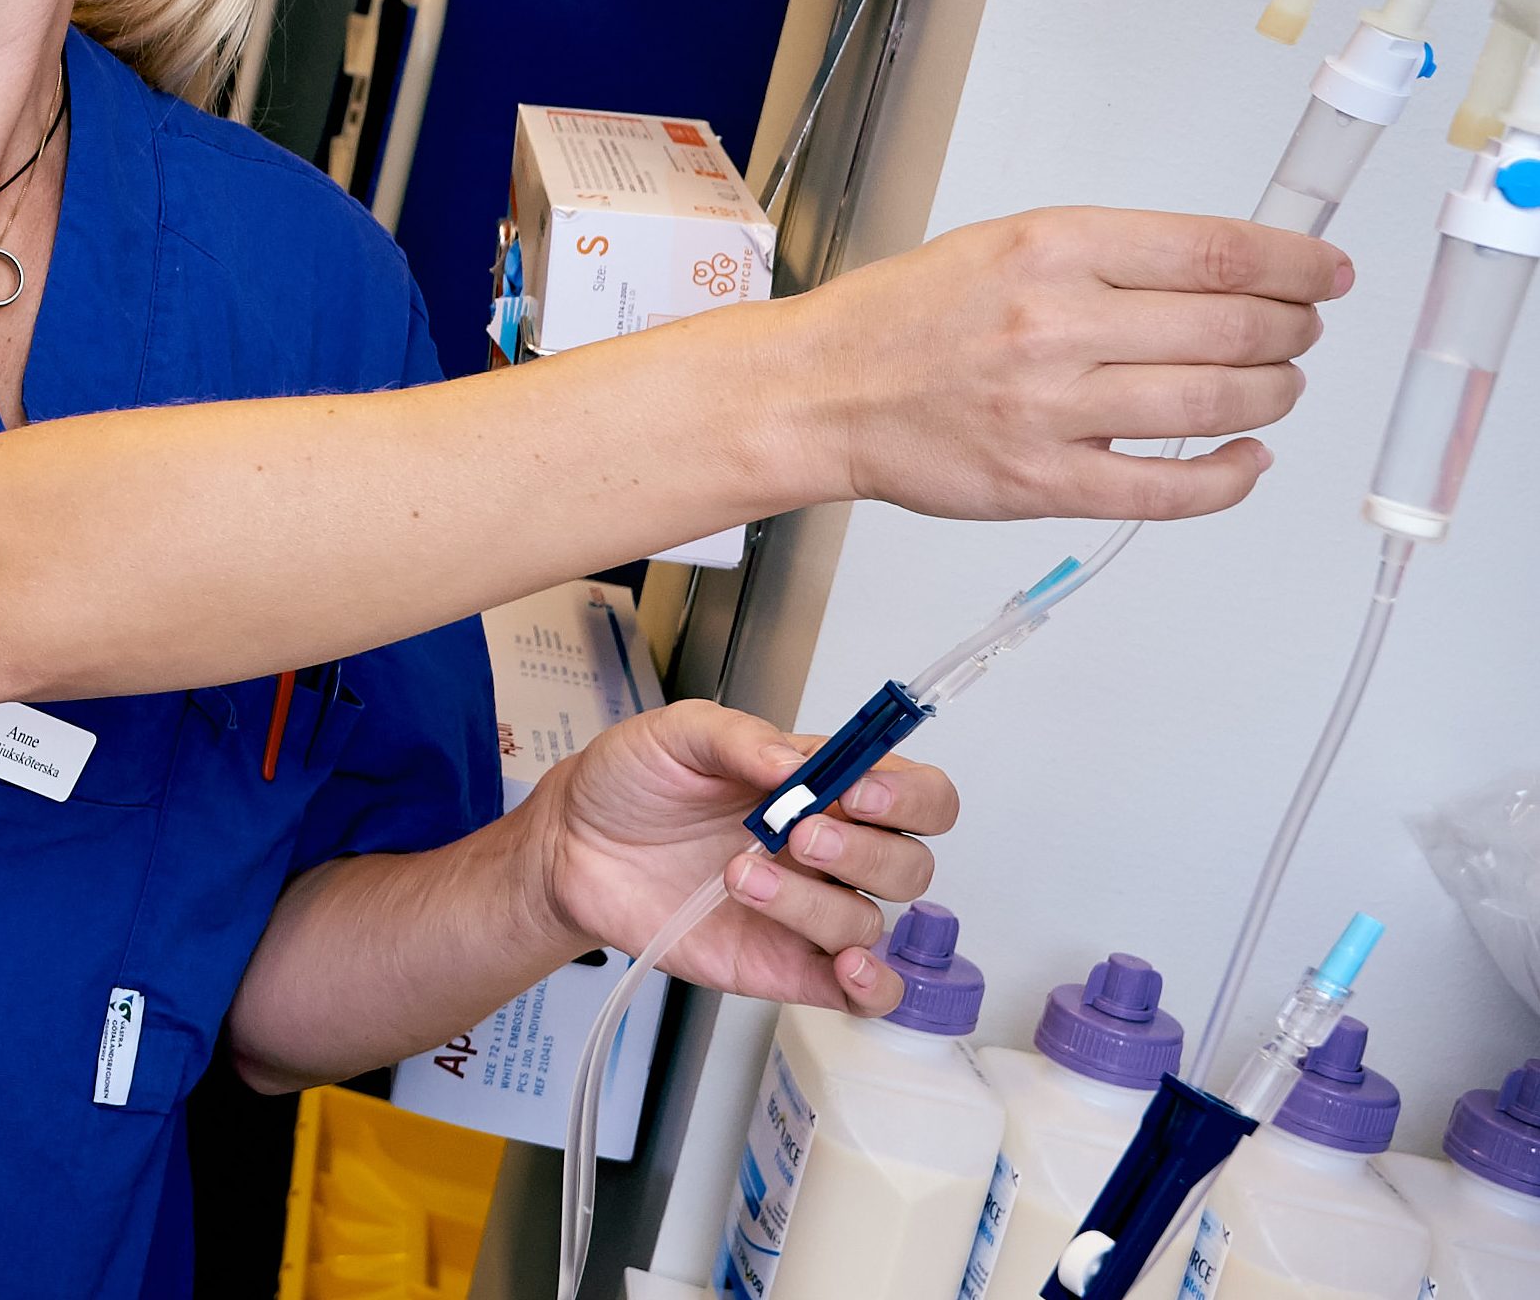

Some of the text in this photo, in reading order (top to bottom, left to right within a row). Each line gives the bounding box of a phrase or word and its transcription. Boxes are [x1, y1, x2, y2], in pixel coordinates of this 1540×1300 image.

[576, 235, 609, 256] S
[592, 264, 607, 292] Size:
[740, 248, 754, 301] vercare
[6, 725, 40, 748] Anne
[493, 1011, 506, 1033] 118
[431, 1022, 481, 1080] Ap
[488, 1045, 500, 1059] 72
[522, 1046, 535, 1069] 100,
[483, 1061, 497, 1087] SIZE
[533, 1034, 554, 1097] REF 210415
[517, 1071, 530, 1093] PCS
